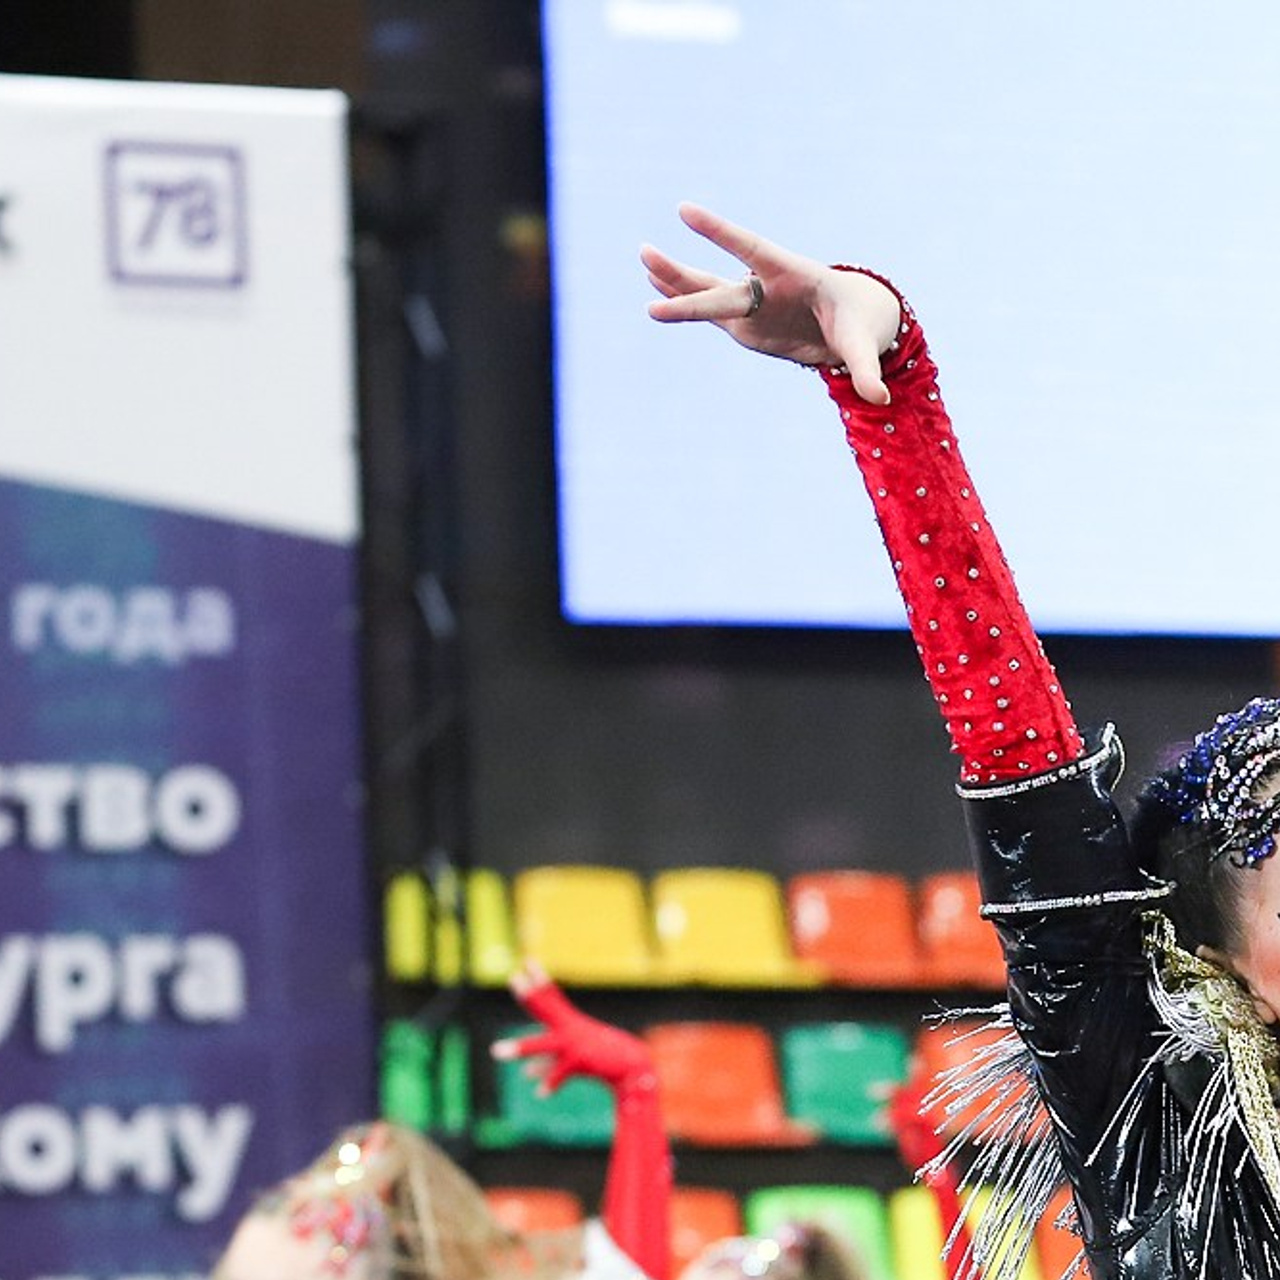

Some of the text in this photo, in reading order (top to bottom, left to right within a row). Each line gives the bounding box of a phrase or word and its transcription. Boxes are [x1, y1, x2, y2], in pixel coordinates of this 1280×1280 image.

[12, 582, 234, 667] года
[0, 762, 241, 855] тво
[0, 1102, 254, 1222] ому
